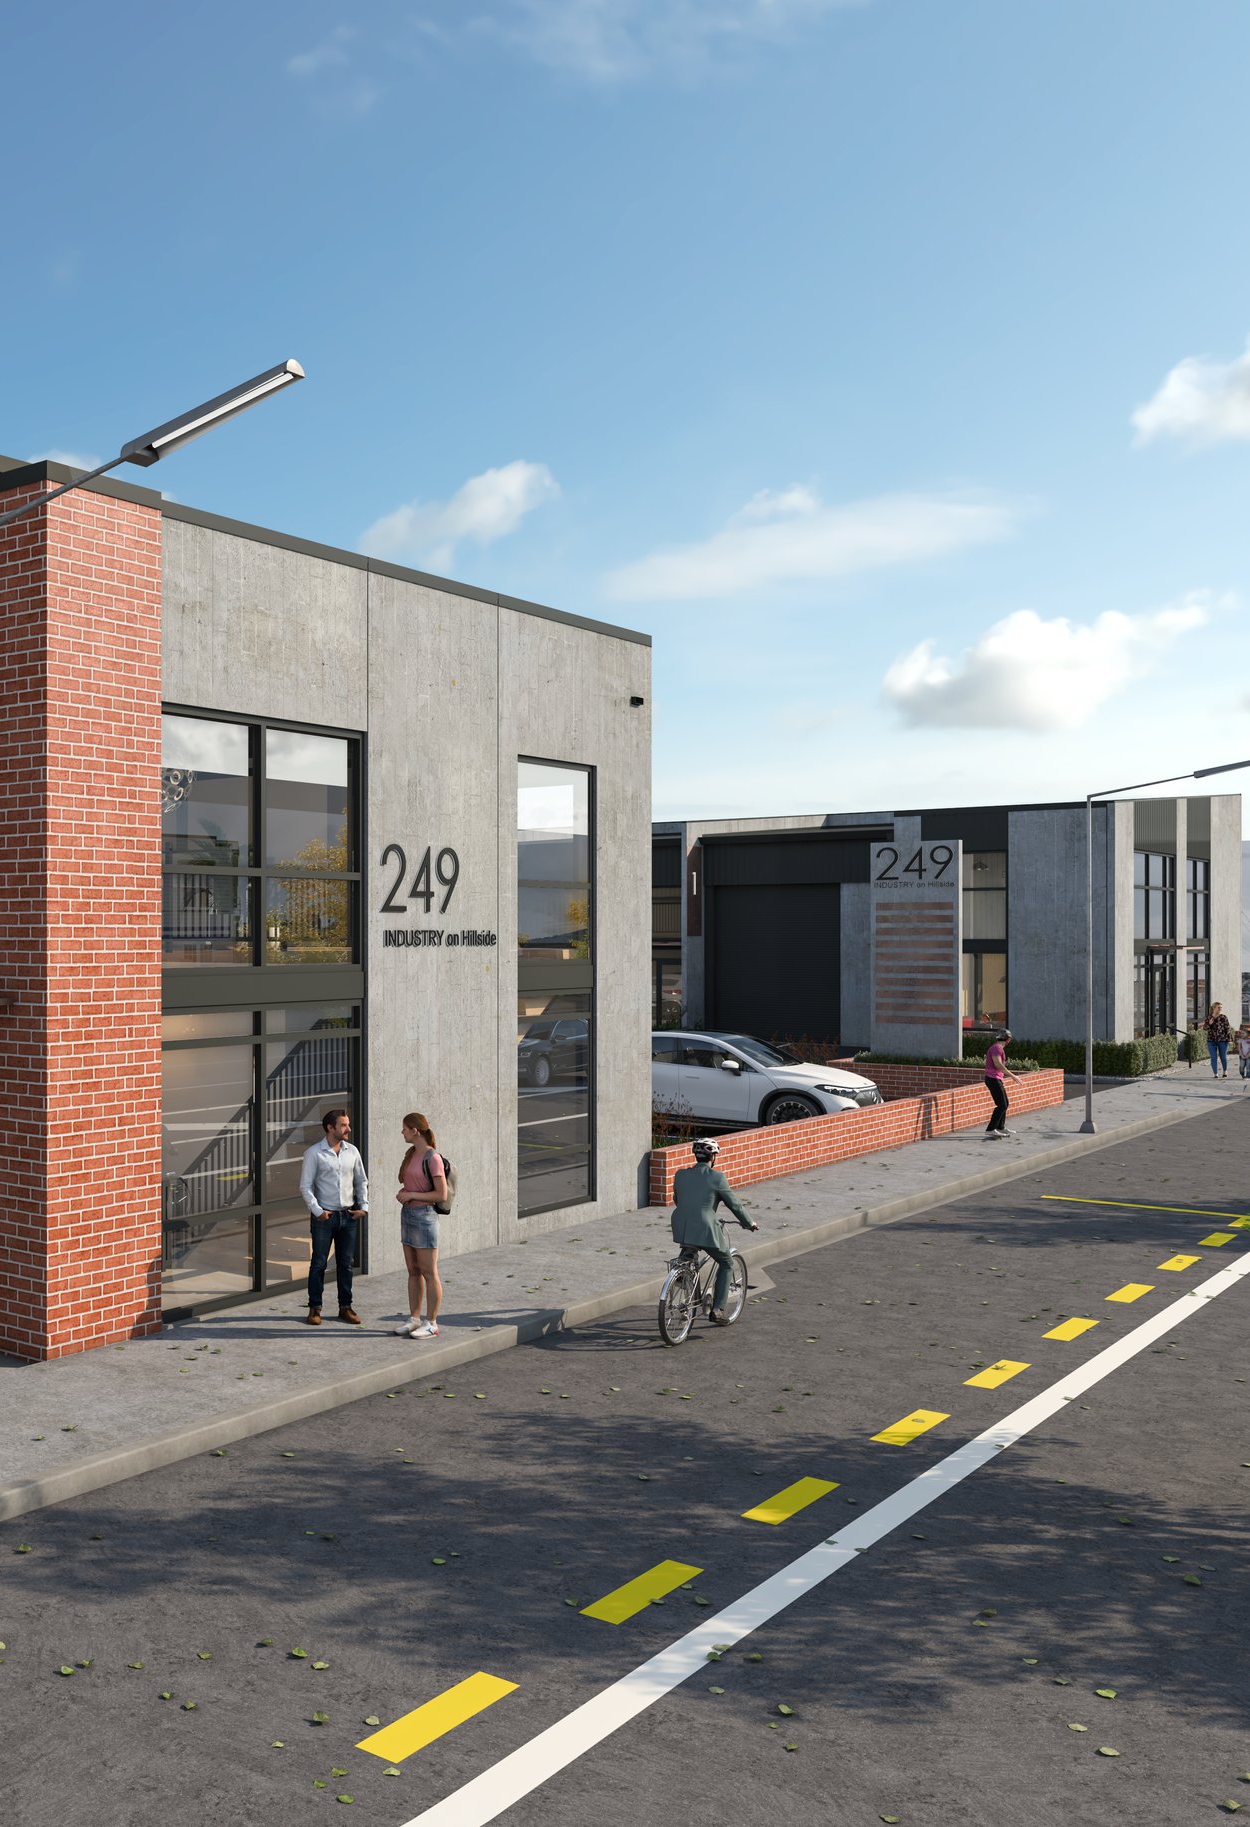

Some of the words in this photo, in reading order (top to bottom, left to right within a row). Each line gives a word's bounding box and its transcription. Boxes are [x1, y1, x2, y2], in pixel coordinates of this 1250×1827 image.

[379, 844, 459, 914] 249
[876, 846, 953, 880] 249
[383, 930, 444, 947] INDUSTRY
[446, 934, 459, 947] on
[461, 930, 496, 947] Hillside
